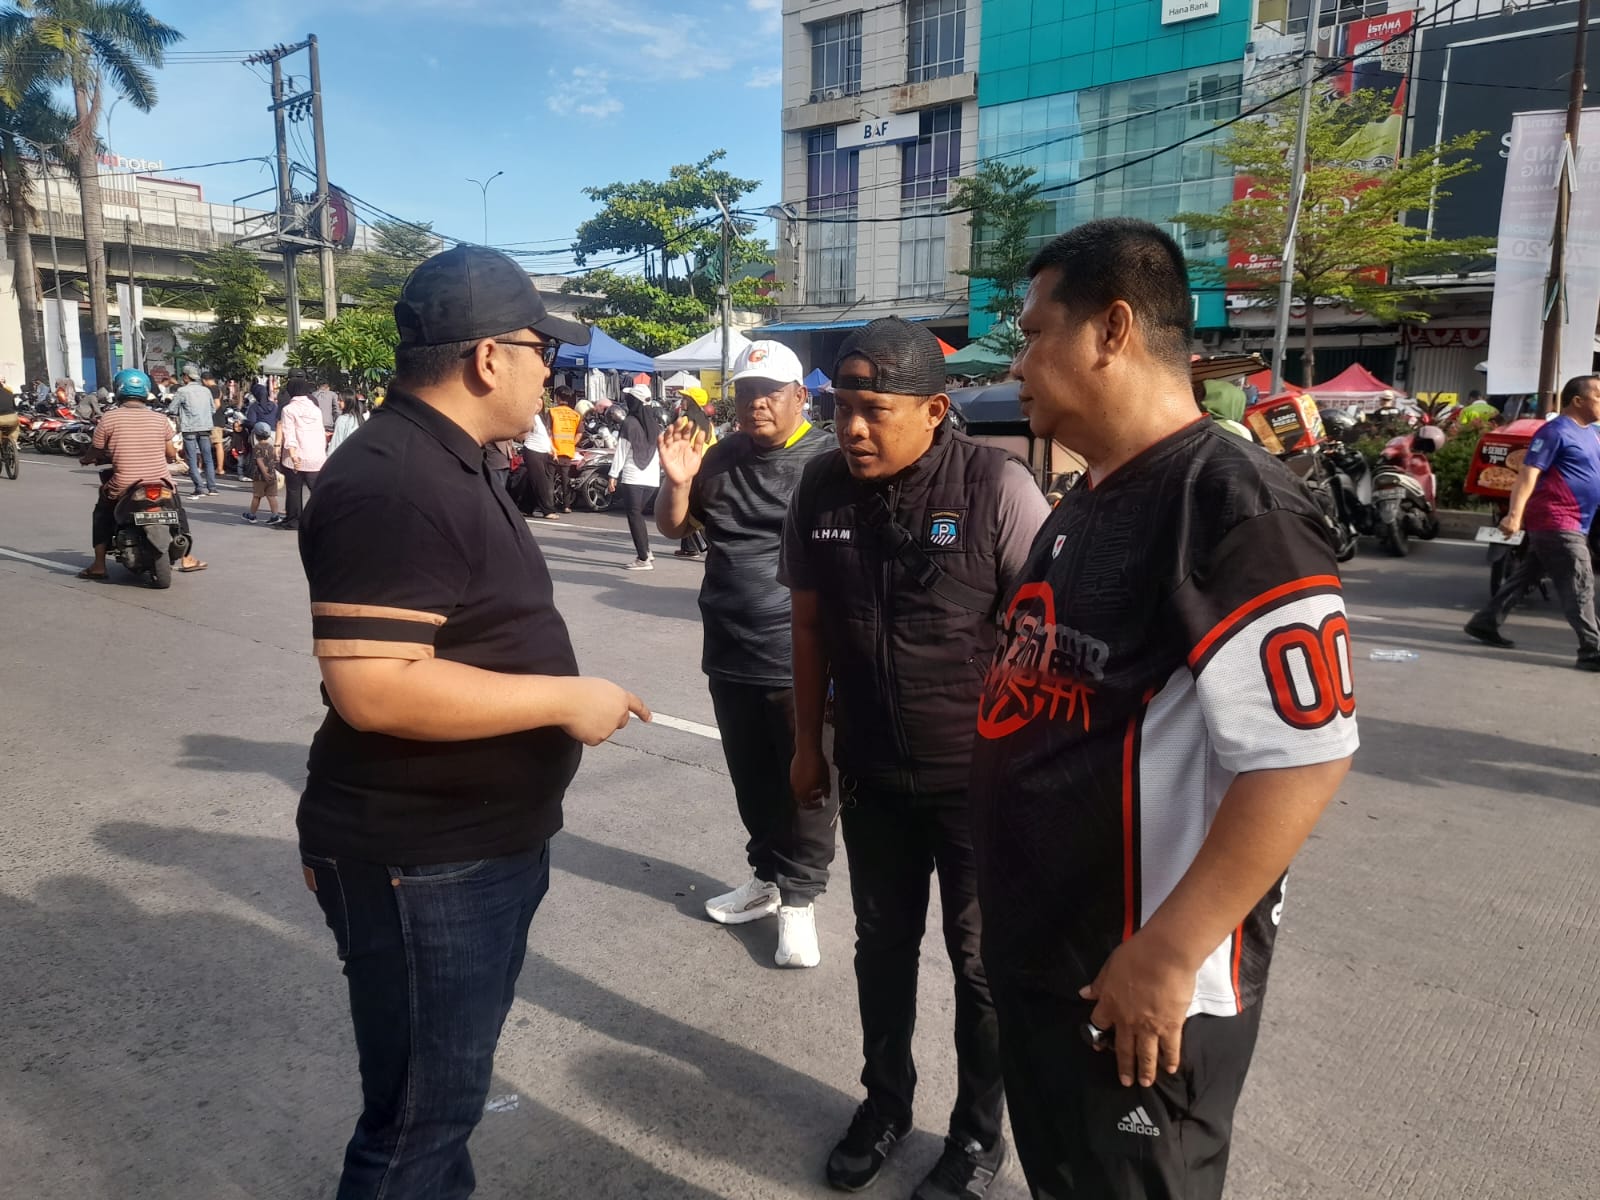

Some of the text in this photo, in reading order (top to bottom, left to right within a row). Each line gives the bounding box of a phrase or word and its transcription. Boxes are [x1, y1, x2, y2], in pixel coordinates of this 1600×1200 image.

[1168, 1, 1209, 16] Hana Bank
[864, 121, 889, 139] BAF
[812, 529, 850, 540] ILHAM
[1117, 1121, 1160, 1136] adidas
